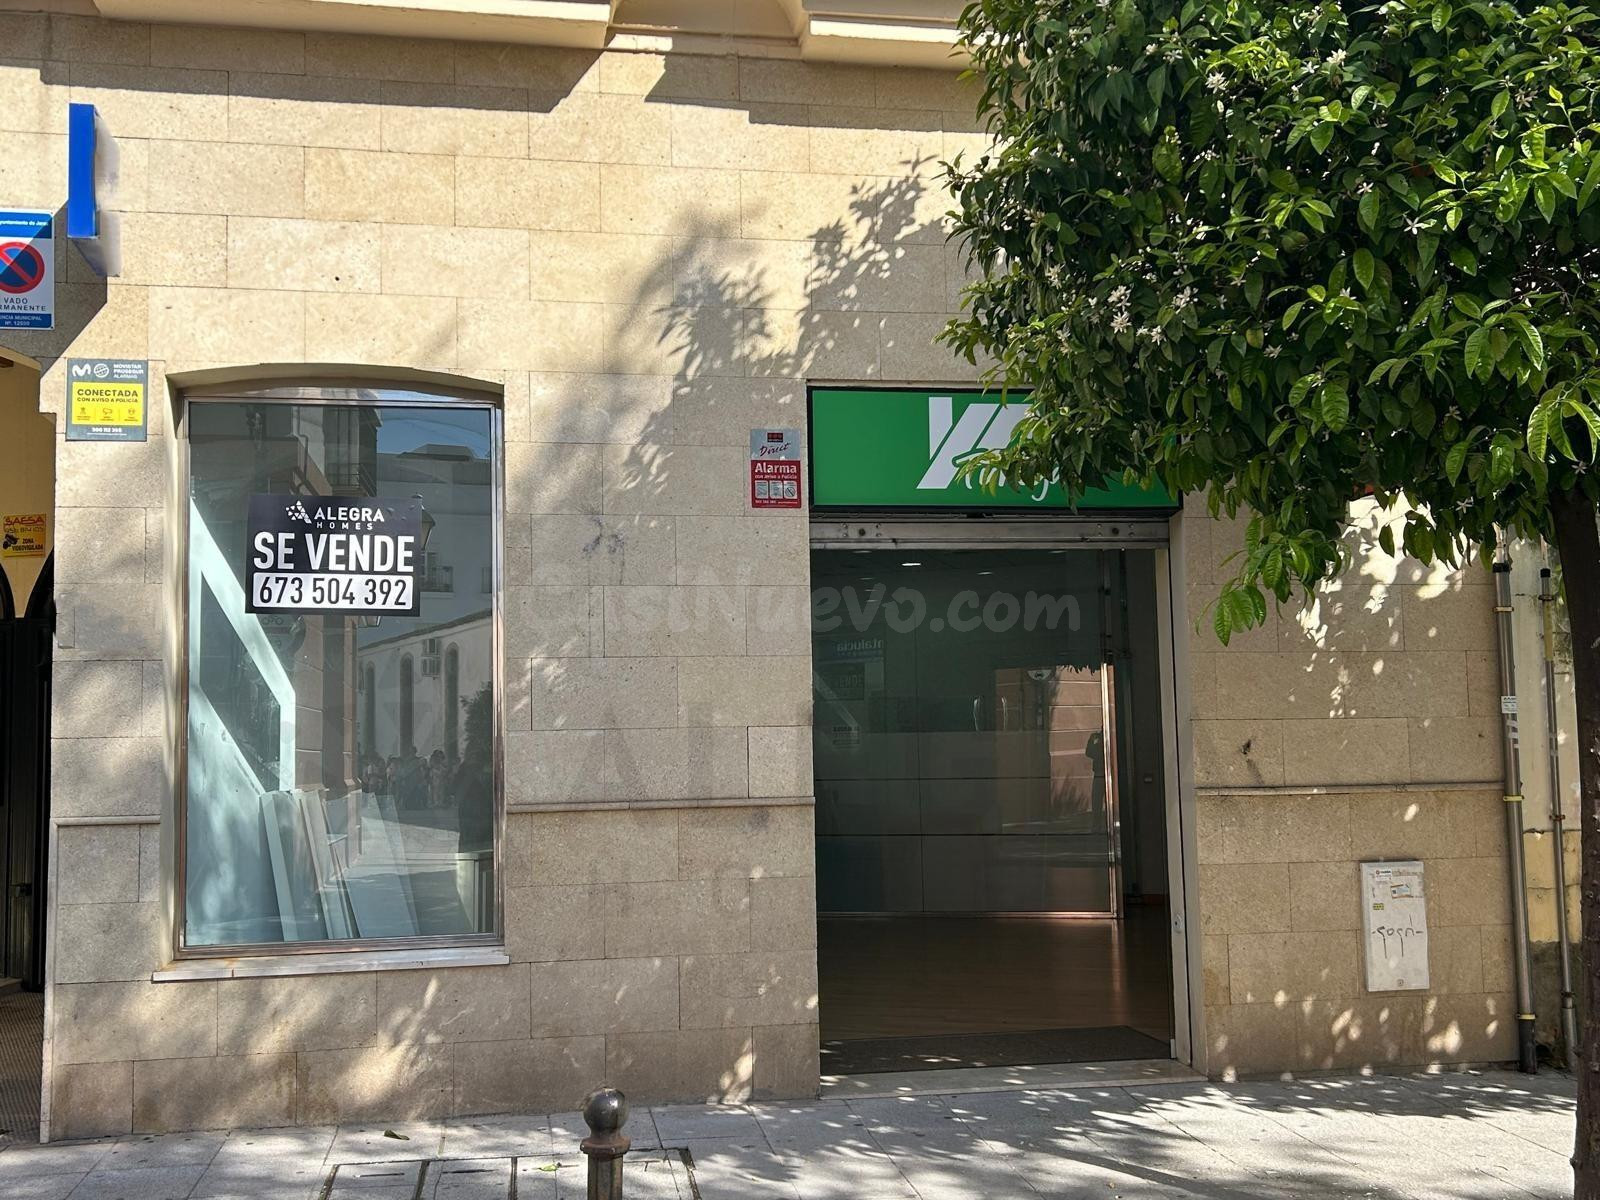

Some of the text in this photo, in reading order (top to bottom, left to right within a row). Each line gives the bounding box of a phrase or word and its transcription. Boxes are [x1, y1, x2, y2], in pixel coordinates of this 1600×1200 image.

[77, 389, 138, 397] CONECTADA
[755, 462, 797, 473] Alarma
[314, 507, 385, 522] ALEGRA
[316, 522, 373, 531] HOMES
[253, 531, 415, 572] SE VENDE
[259, 576, 407, 606] 673 504 392
